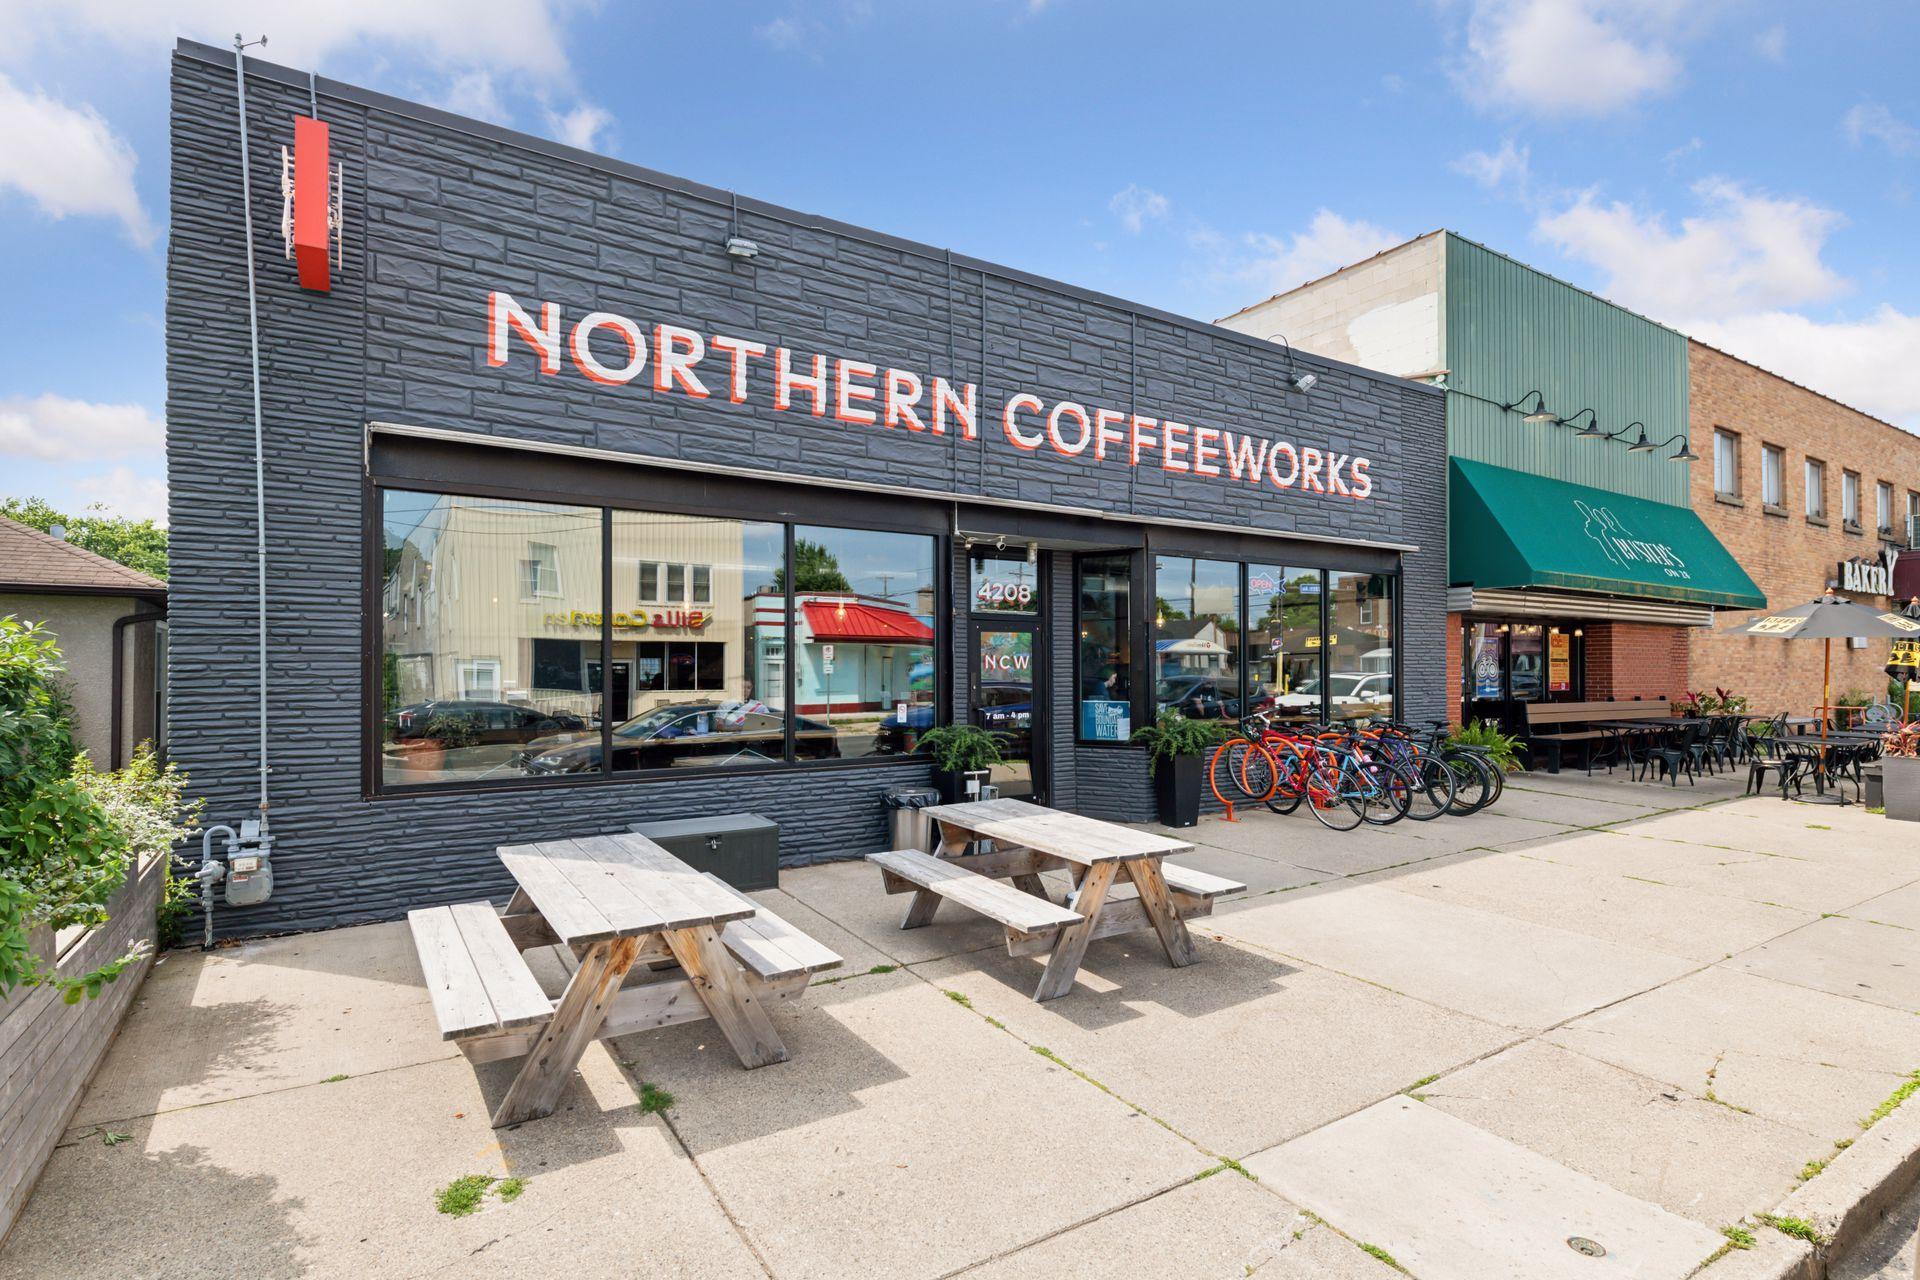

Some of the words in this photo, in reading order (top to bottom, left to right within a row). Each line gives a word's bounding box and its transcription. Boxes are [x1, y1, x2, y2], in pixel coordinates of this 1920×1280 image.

[487, 291, 977, 441] NORTHERN
[1003, 393, 1373, 499] COFFEEWORKS
[1841, 546, 1899, 596] BAKERY
[977, 582, 1031, 603] 4208
[984, 654, 1029, 671] NCW
[986, 712, 992, 720] 7
[1011, 711, 1016, 719] 4
[1018, 711, 1030, 720] pm
[1095, 724, 1118, 737] WATER
